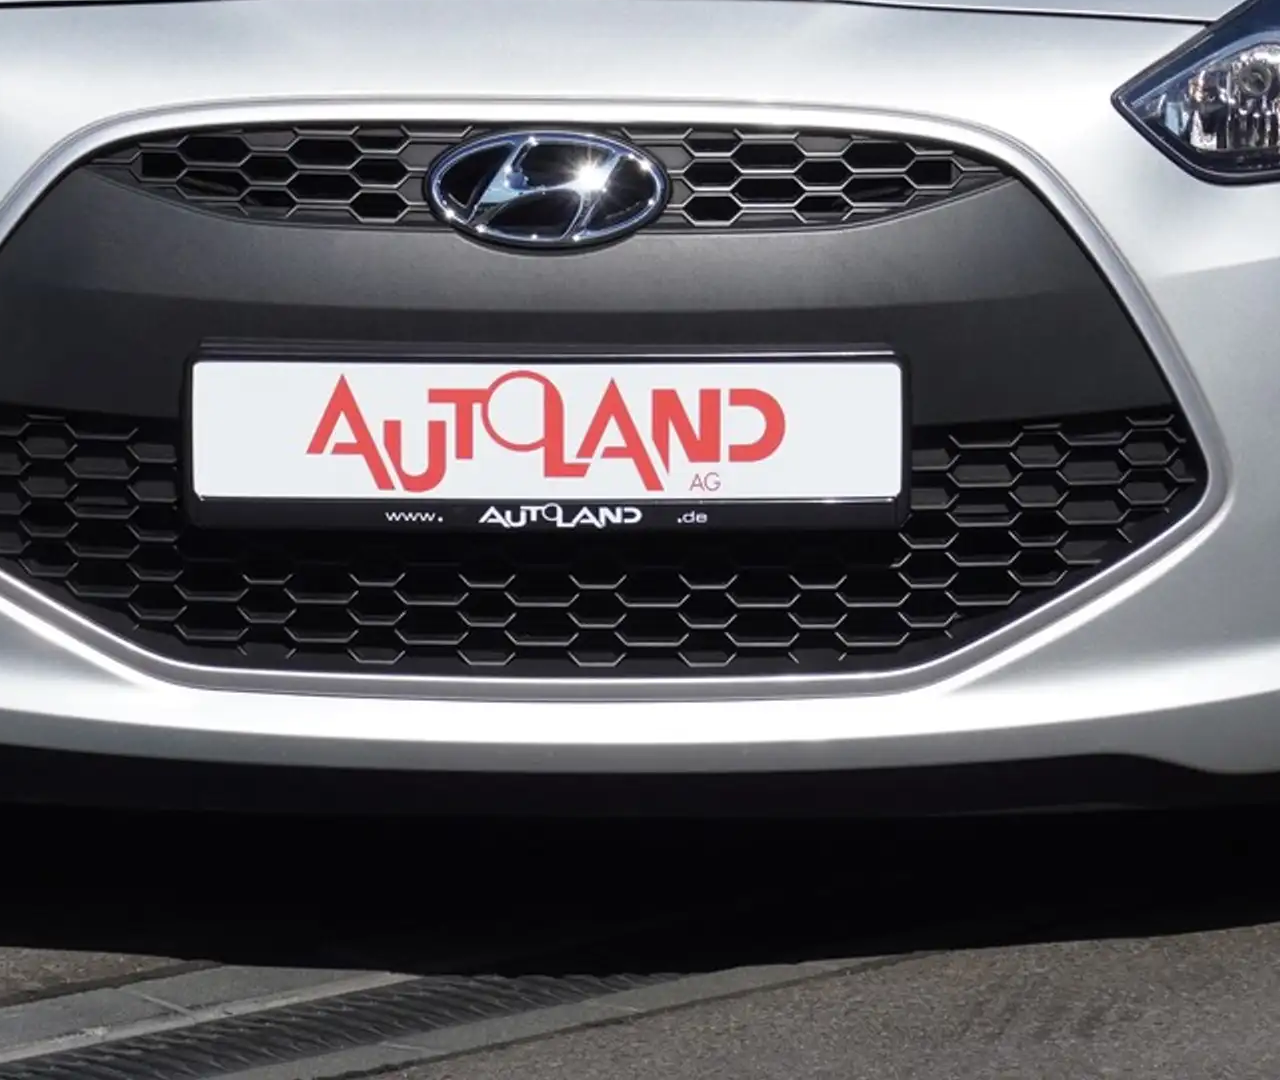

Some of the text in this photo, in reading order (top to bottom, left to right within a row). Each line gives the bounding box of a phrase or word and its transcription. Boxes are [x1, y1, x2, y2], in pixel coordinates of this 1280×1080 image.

[306, 370, 786, 492] AUTOLAND
[689, 472, 722, 492] AG
[385, 512, 444, 522] www.
[478, 503, 643, 529] AUTOLAND
